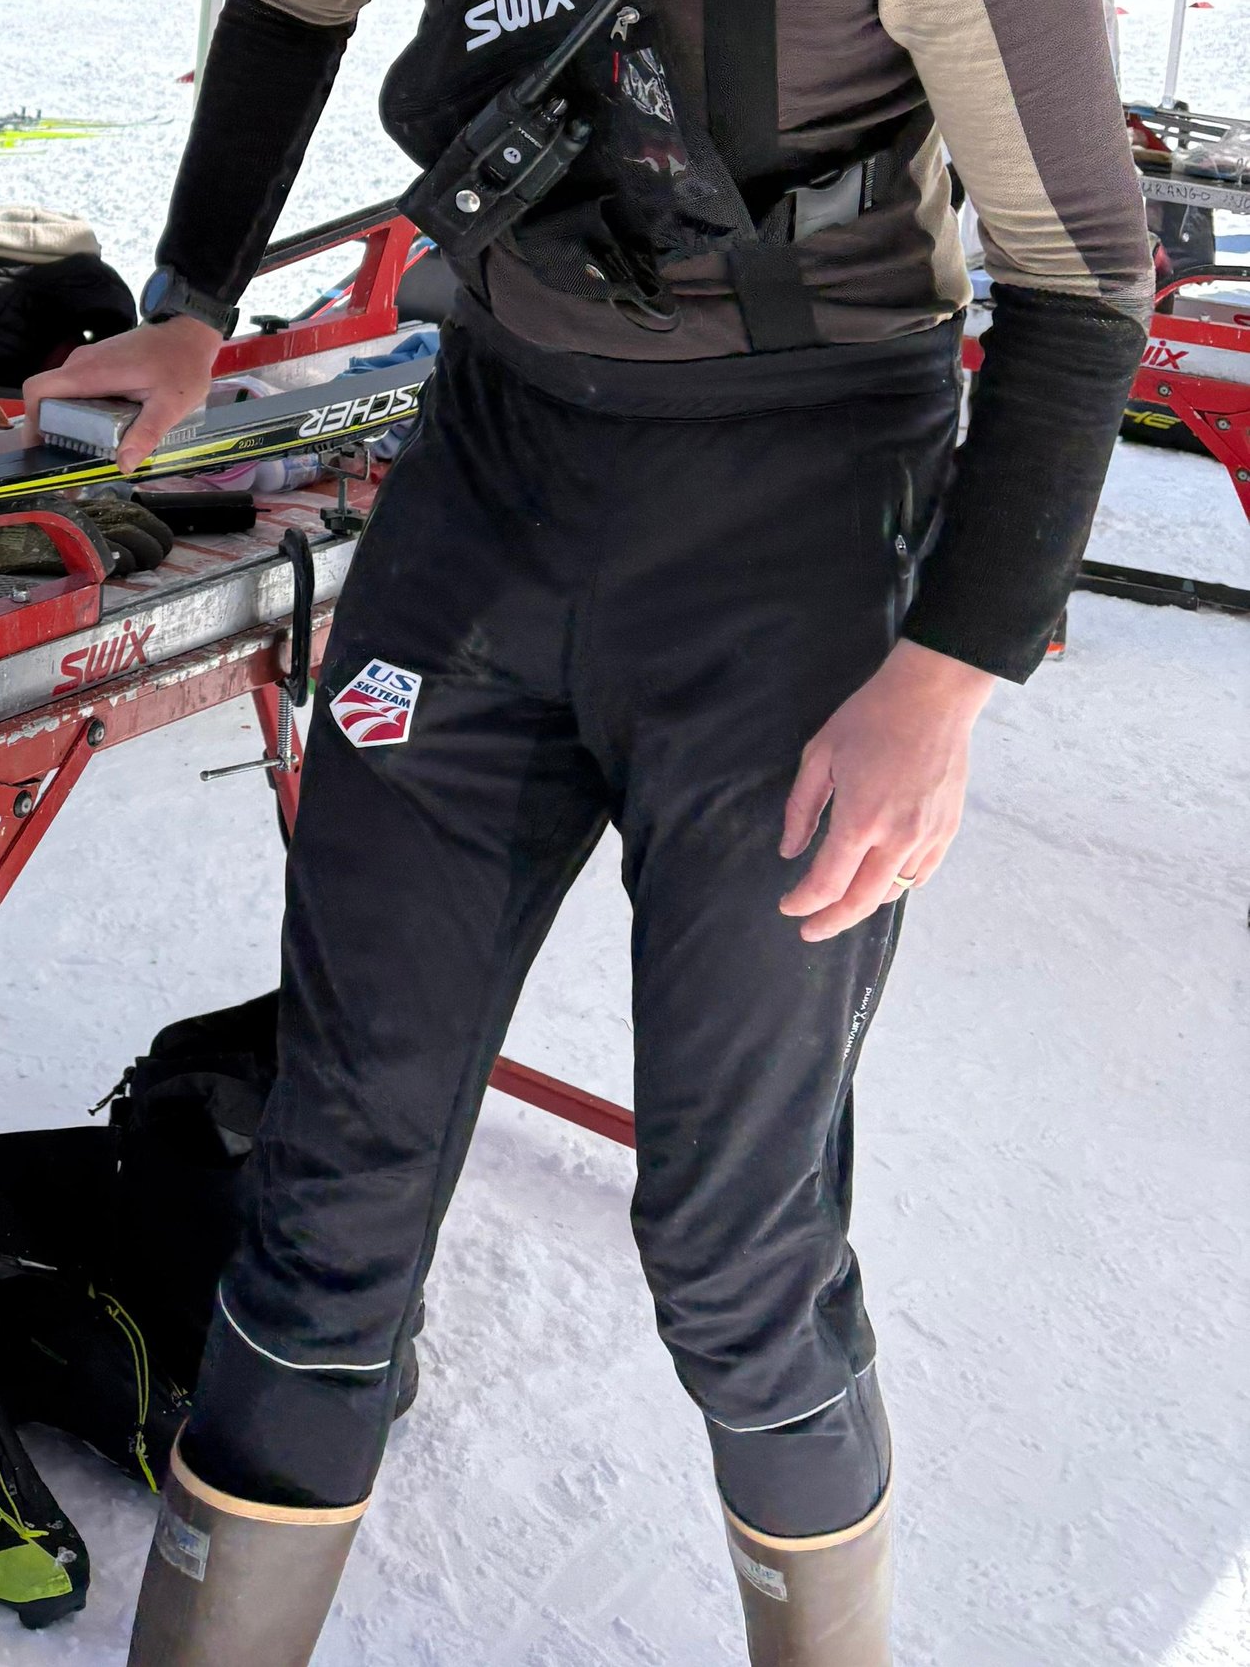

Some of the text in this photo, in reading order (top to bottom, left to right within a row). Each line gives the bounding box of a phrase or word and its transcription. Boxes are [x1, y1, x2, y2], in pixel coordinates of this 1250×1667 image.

[298, 381, 425, 439] SCHER
[366, 664, 417, 692] US
[353, 680, 411, 710] SKI TEAM
